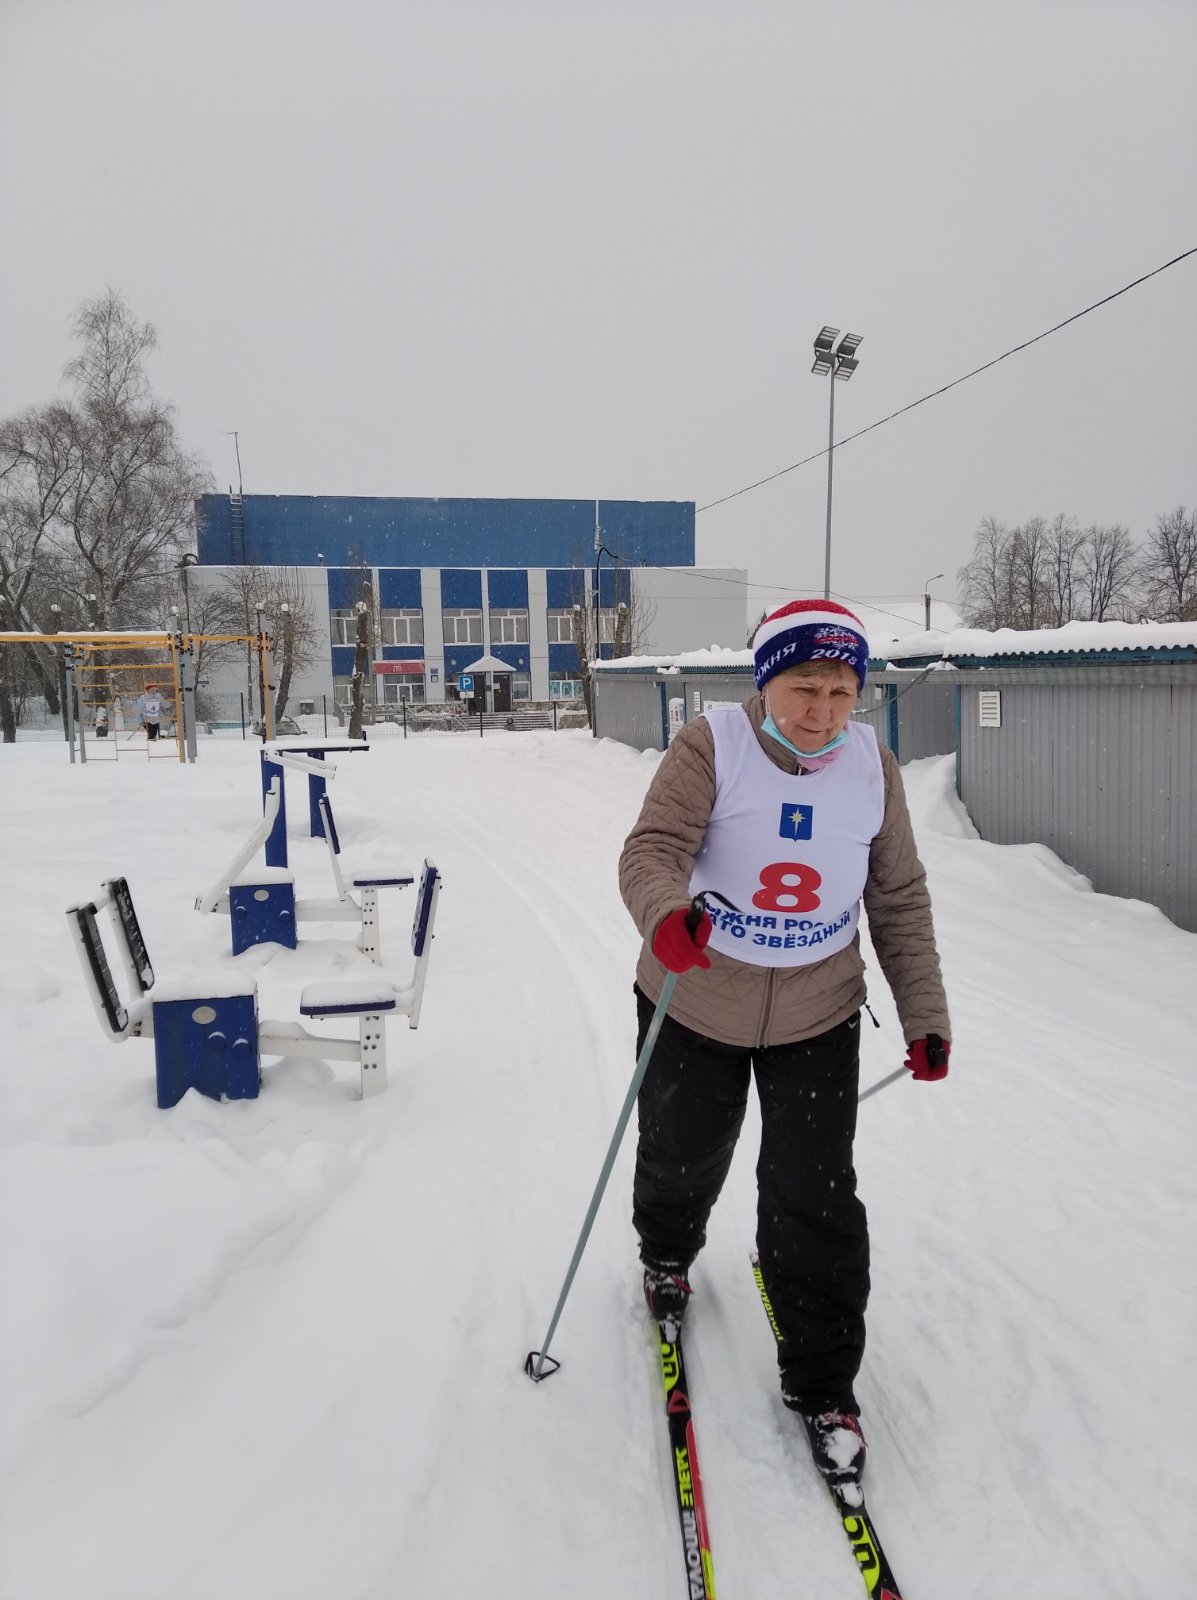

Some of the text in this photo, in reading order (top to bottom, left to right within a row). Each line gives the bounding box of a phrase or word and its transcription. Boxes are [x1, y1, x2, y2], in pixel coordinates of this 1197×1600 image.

[756, 642, 797, 681] ЫЖНЯ
[810, 649, 858, 665] 2018
[463, 677, 471, 689] P
[752, 862, 822, 913] 8
[705, 903, 777, 929] ЫЖНЯ
[709, 911, 850, 949] АТО ЗВЁЗДНЫЙ
